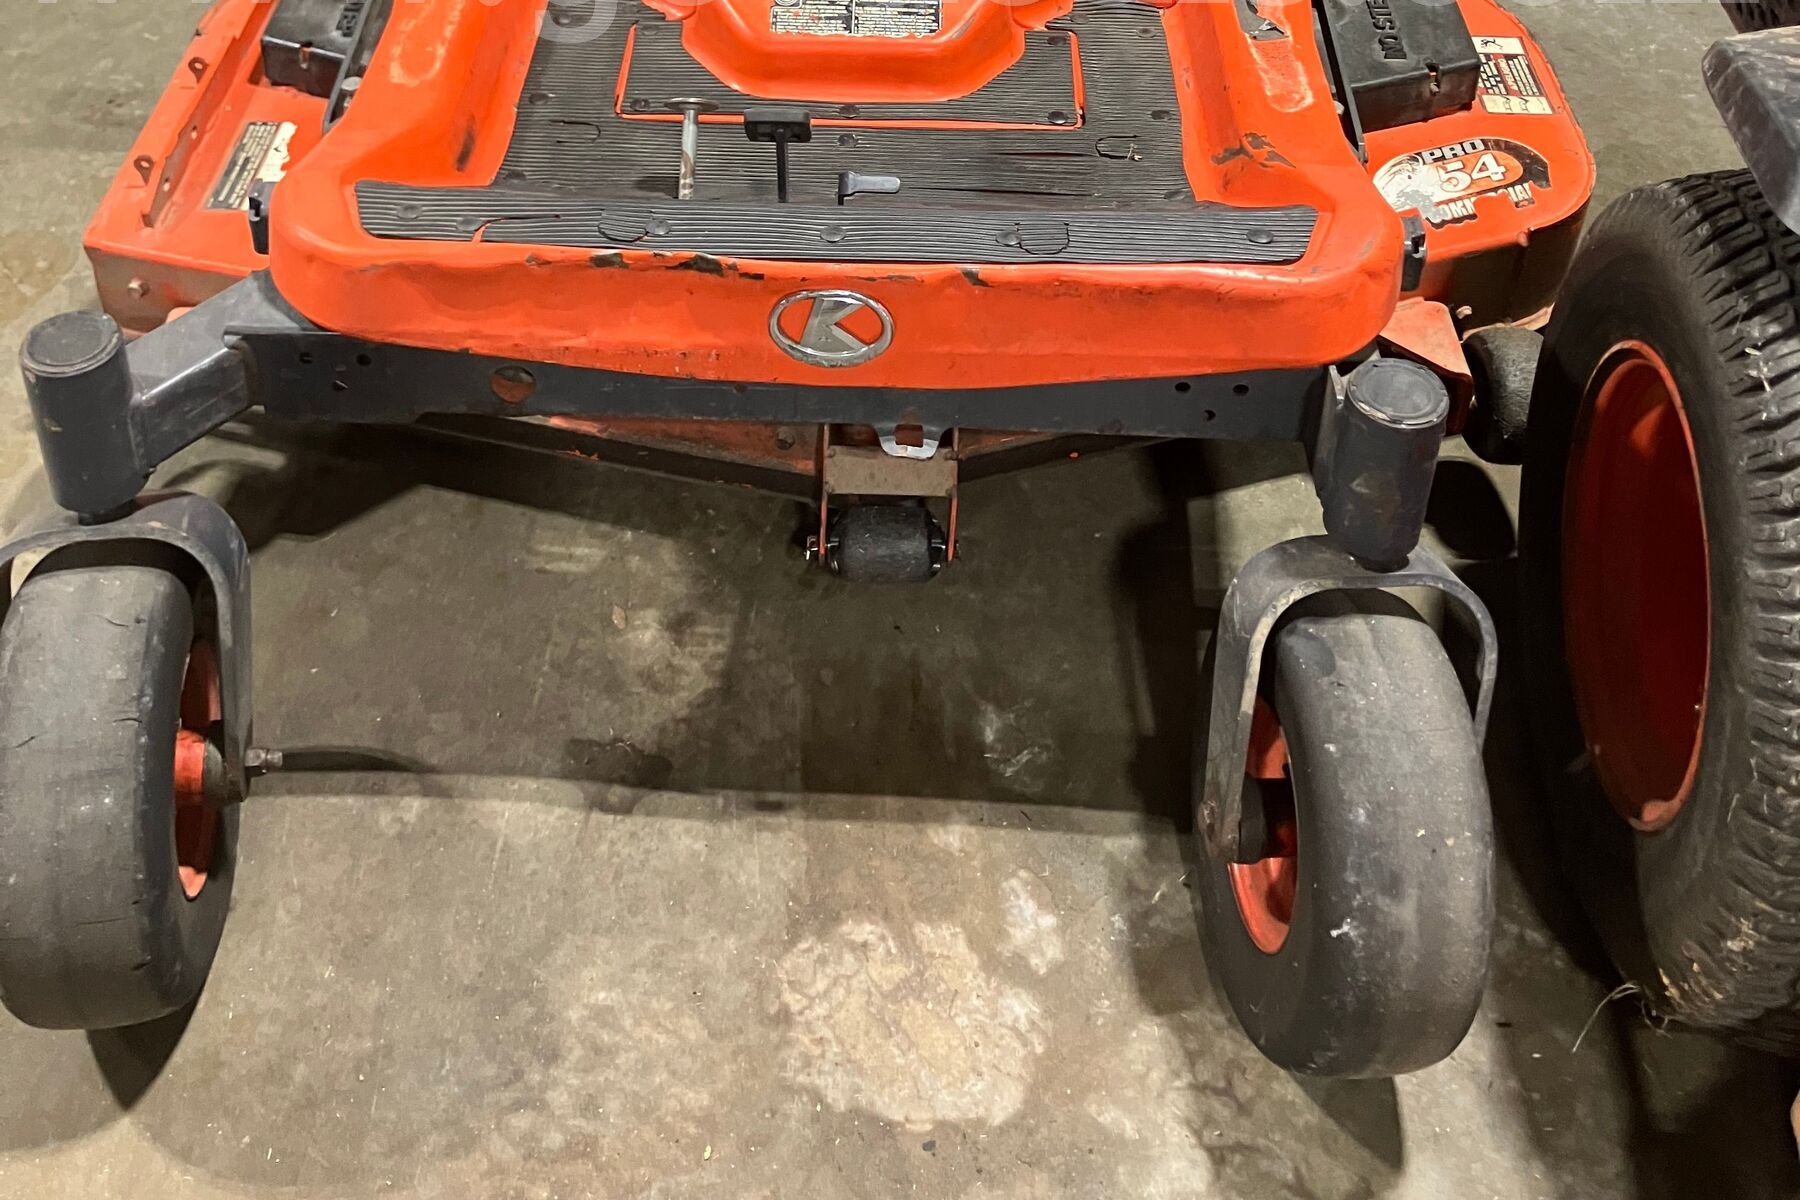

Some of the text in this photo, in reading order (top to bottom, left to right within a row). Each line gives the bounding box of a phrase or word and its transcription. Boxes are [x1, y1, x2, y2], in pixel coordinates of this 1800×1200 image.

[1378, 31, 1408, 62] NO
[1421, 139, 1485, 165] PRO
[1437, 152, 1507, 193] 54
